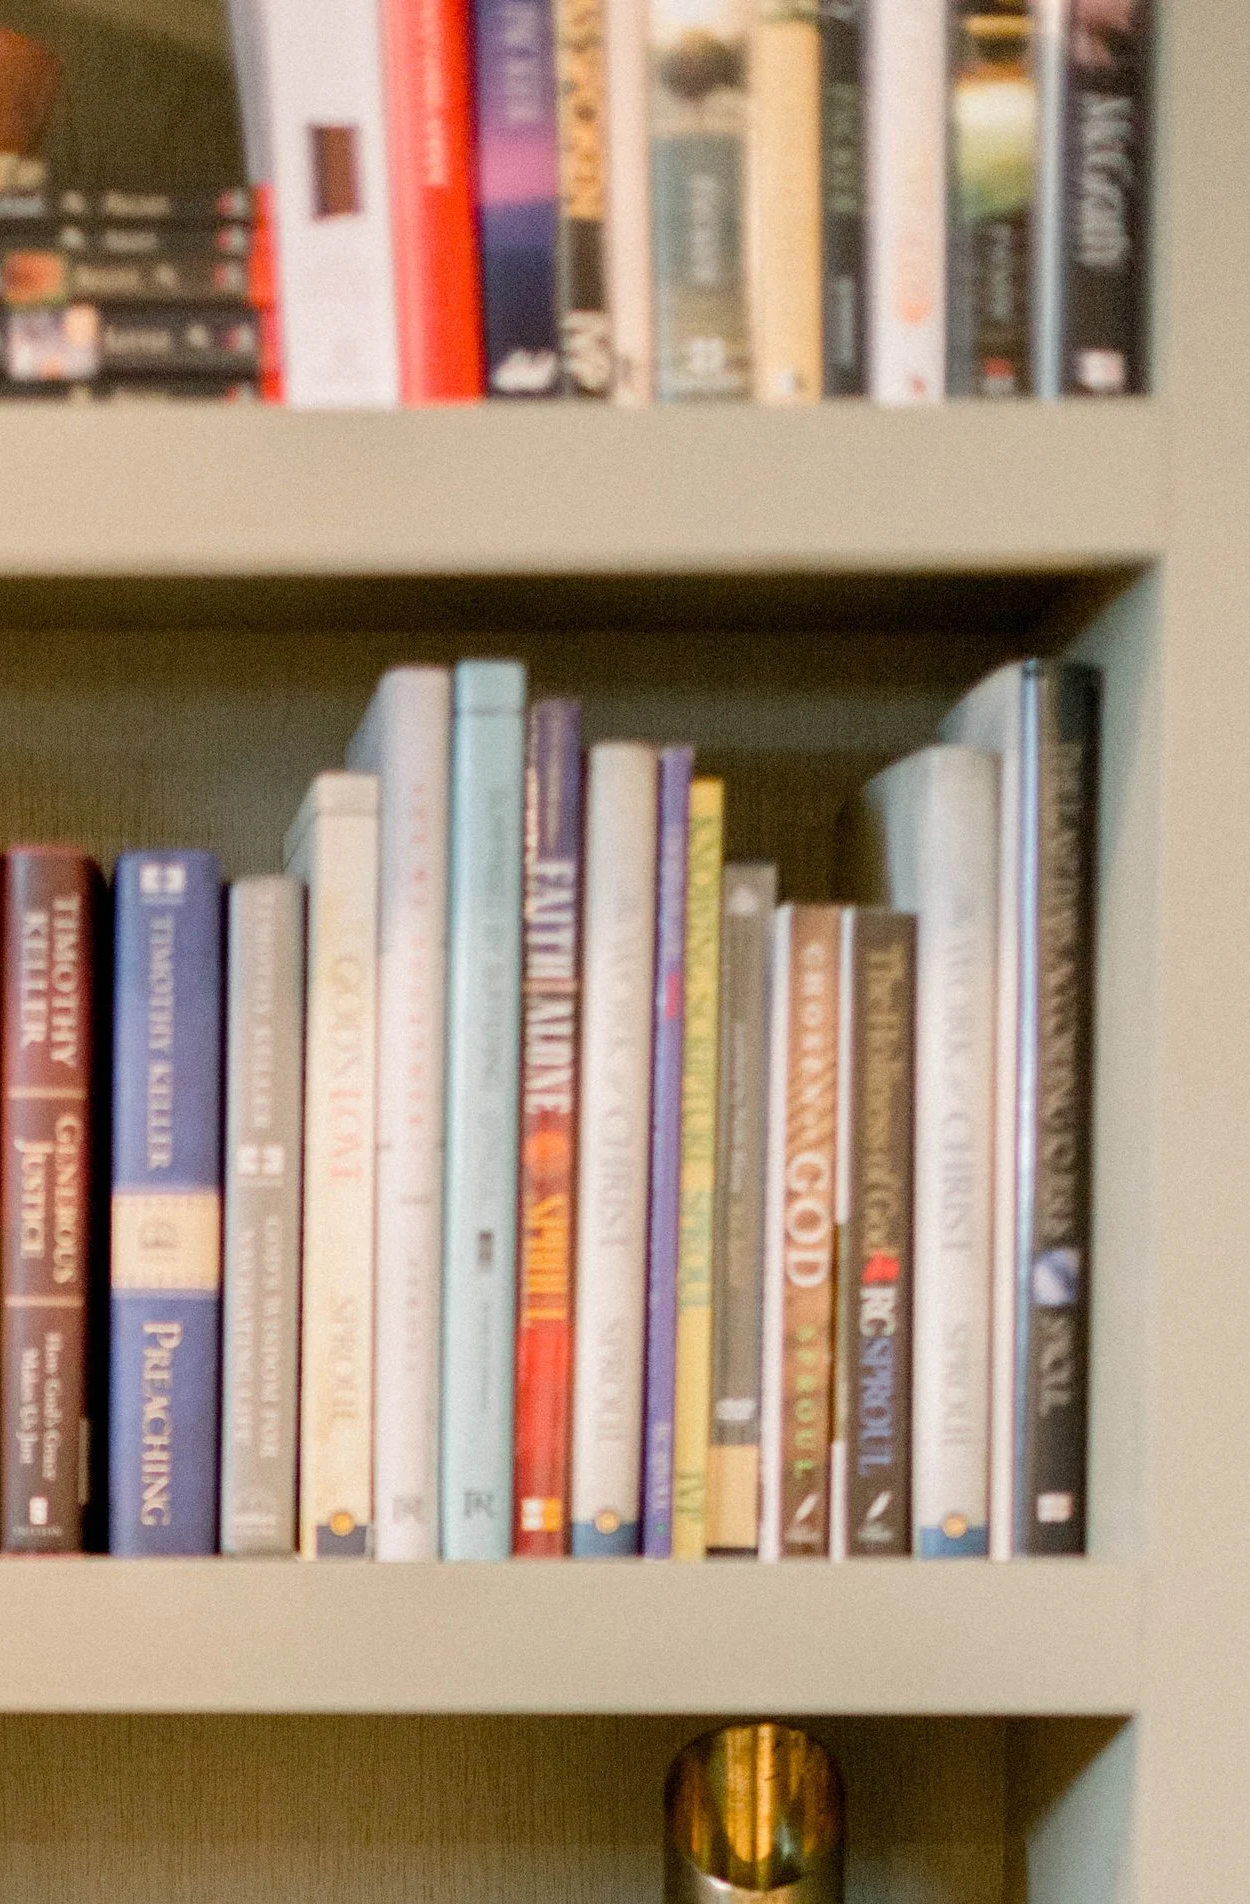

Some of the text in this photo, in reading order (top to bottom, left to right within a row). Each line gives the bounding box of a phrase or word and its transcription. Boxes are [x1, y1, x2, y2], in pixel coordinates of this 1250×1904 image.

[20, 910, 49, 1048] KELLER
[50, 891, 81, 1070] TIMOTHY
[148, 916, 174, 1170] TIMOTHY KELLER
[526, 860, 576, 1115] FAITH ALONE
[14, 1139, 54, 1259] JUSTICE
[52, 1114, 79, 1284] GENEROUS
[785, 1150, 831, 1288] GOD
[940, 1109, 978, 1257] CHRIST
[140, 1319, 182, 1526] PREACHING
[792, 1323, 819, 1479] SPROUL
[857, 1286, 899, 1476] RC SPROUL
